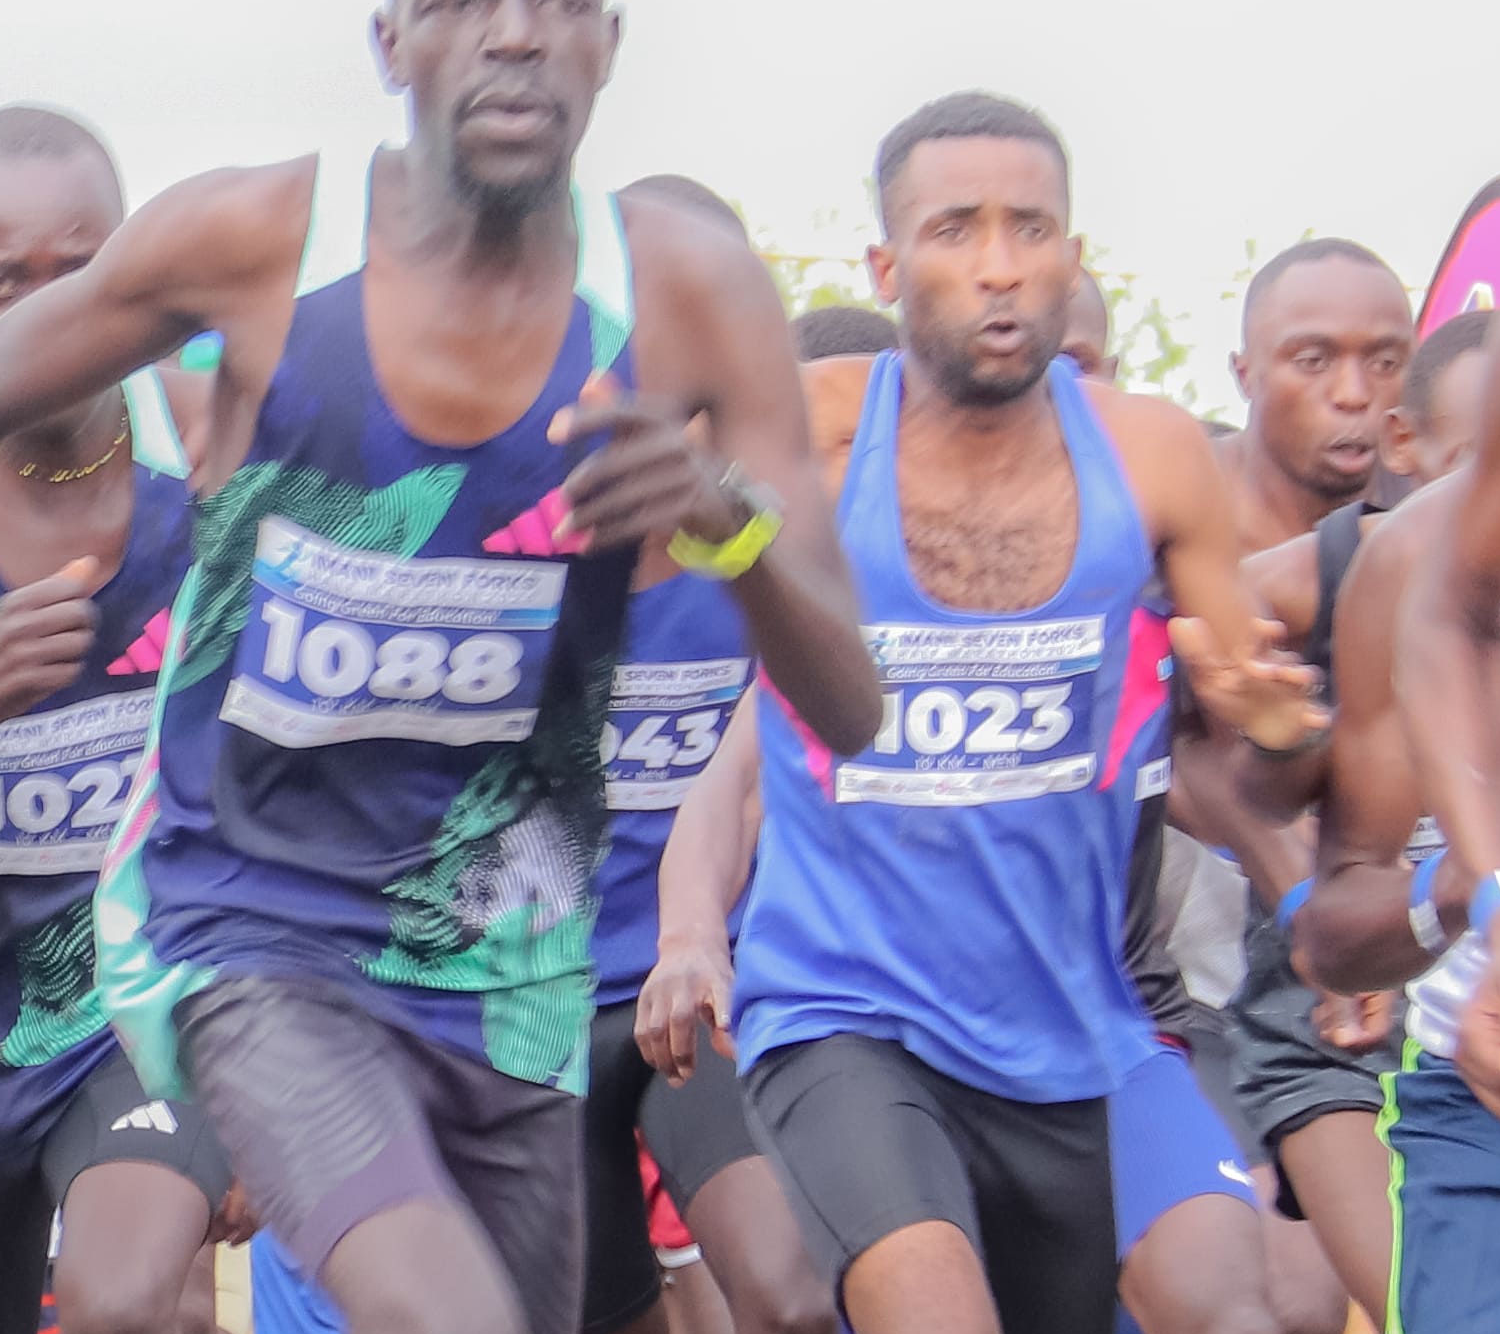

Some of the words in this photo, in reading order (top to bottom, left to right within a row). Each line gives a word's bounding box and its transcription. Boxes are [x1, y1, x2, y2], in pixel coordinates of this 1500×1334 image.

[261, 595, 525, 705] 1088
[114, 698, 155, 715] FOR
[599, 708, 722, 769] 43
[873, 682, 1074, 756] 1023
